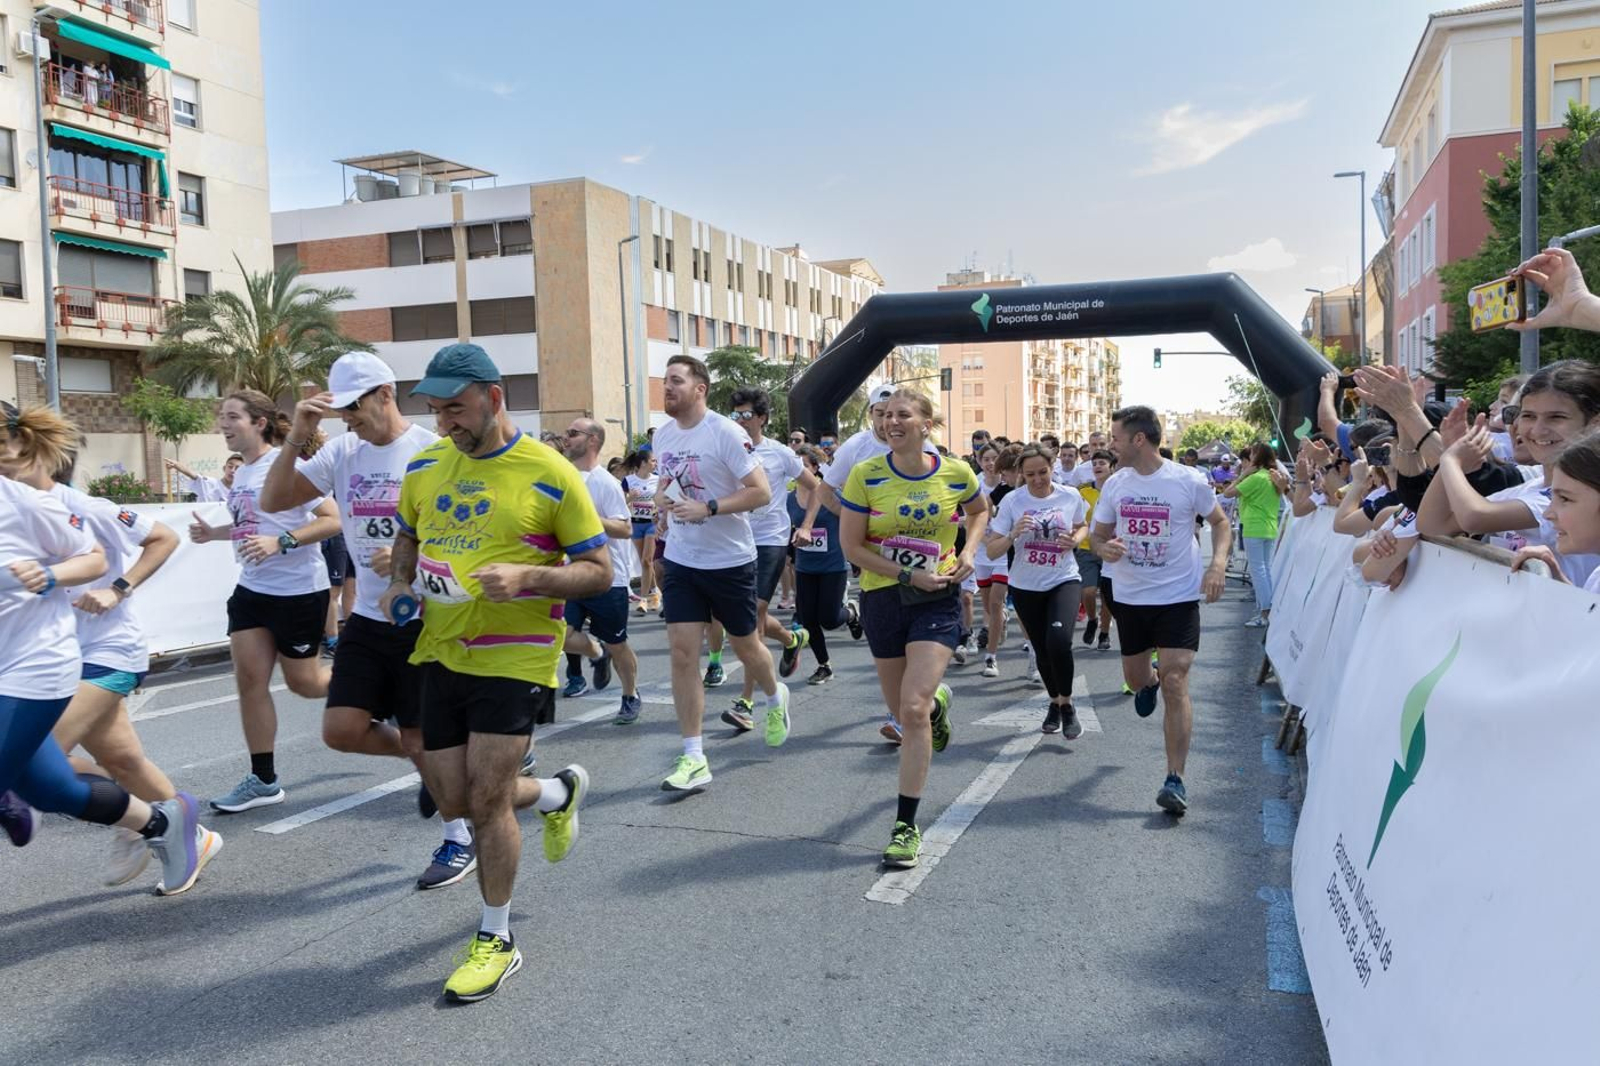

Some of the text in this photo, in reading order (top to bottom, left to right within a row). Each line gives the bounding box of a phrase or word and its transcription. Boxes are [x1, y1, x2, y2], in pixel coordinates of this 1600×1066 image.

[996, 299, 1105, 313] Patronato Municipal de
[996, 311, 1079, 325] Deportes de Jaén
[366, 517, 394, 538] 63
[1128, 518, 1161, 536] 835
[425, 534, 482, 551] maristas
[891, 548, 928, 570] 162
[1028, 550, 1057, 567] 834
[420, 569, 450, 597] 161
[1333, 832, 1393, 972] Patronato Municipal de
[1326, 871, 1372, 989] Deportes de Jaén
